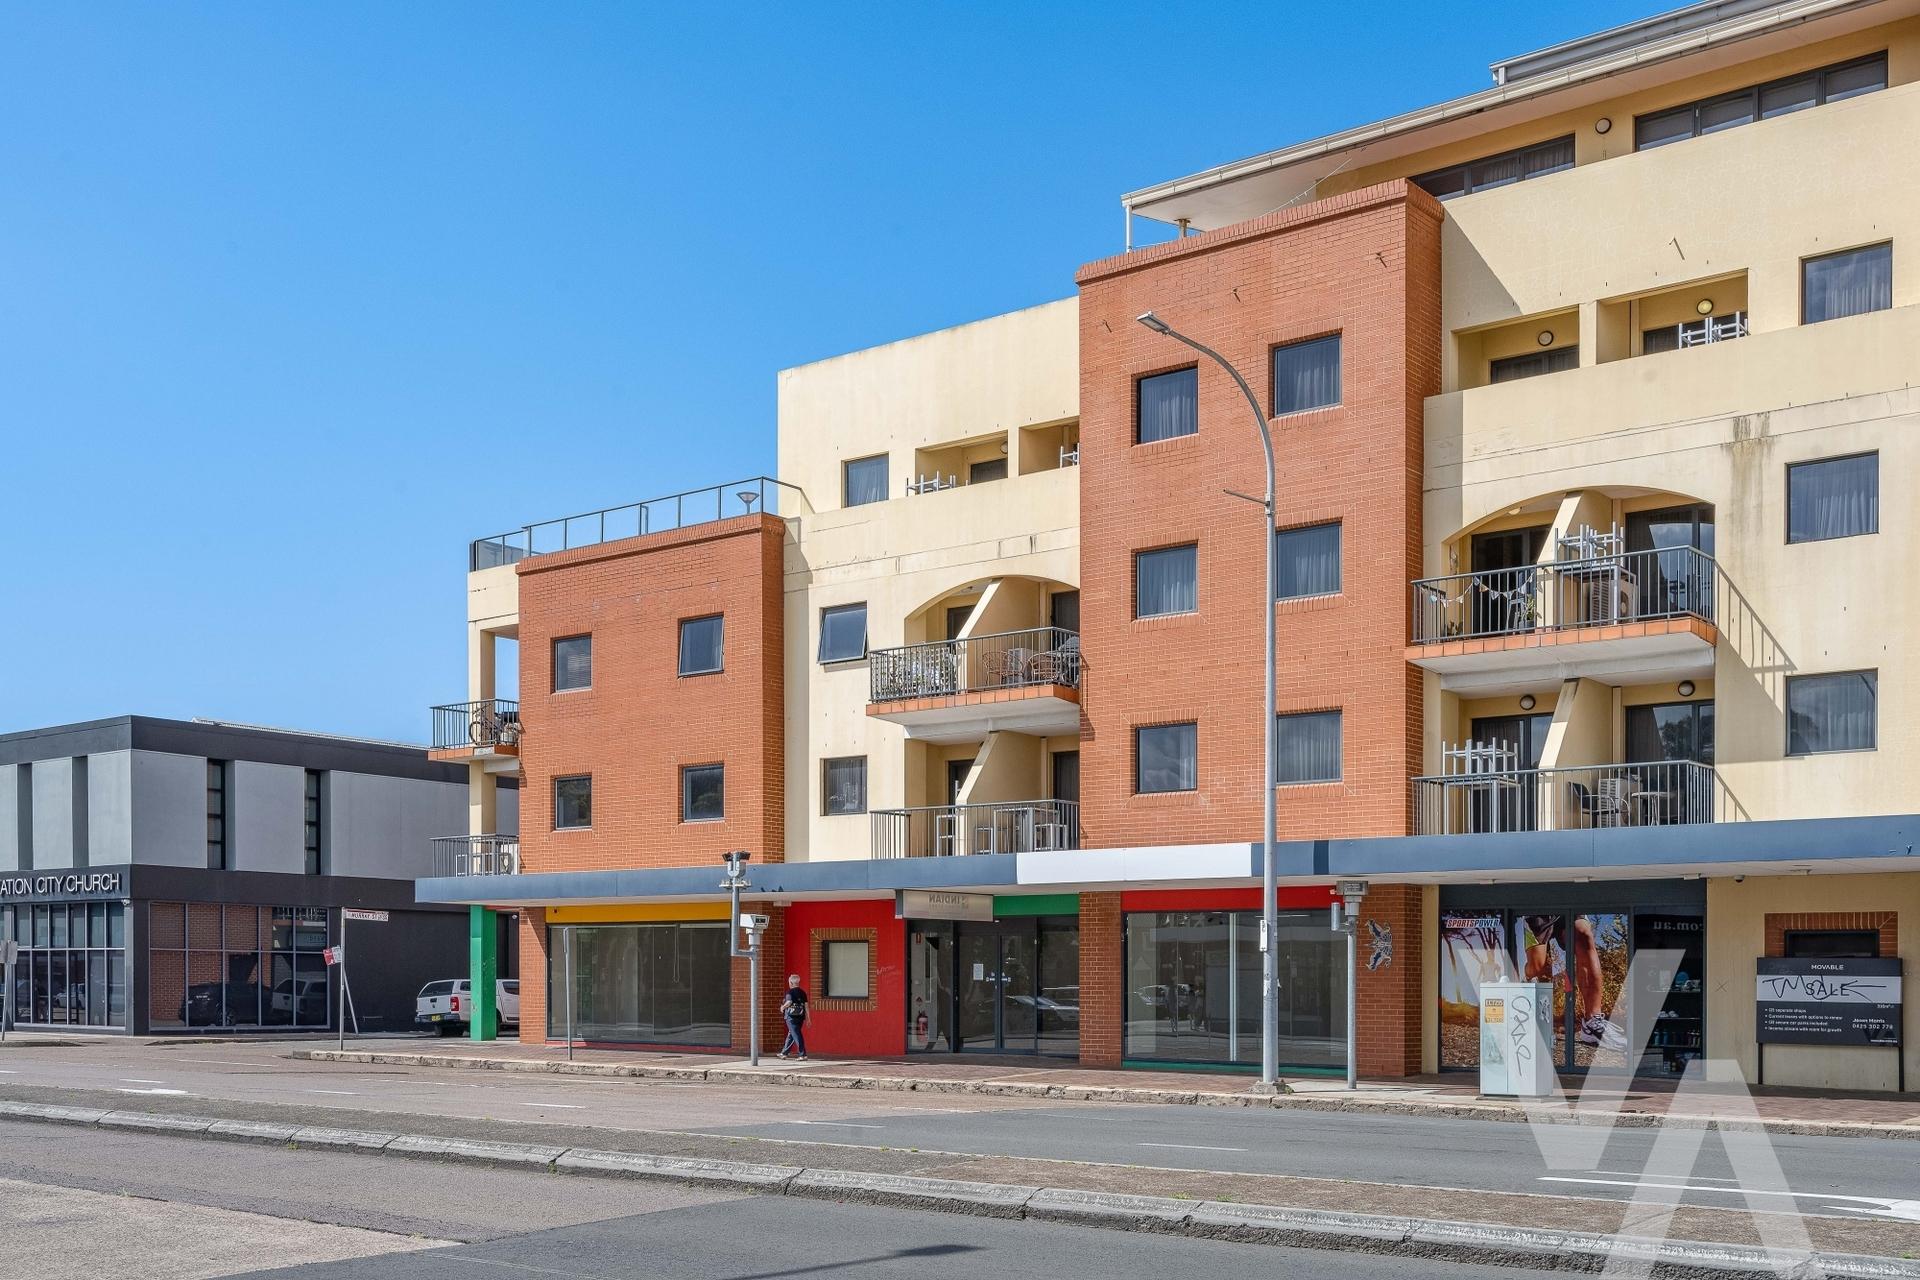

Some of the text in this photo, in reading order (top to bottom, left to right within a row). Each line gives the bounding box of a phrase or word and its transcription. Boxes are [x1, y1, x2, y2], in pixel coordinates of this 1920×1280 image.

[0, 873, 119, 895] ATION CITY CHURCH
[1806, 983, 1849, 996] SALE
